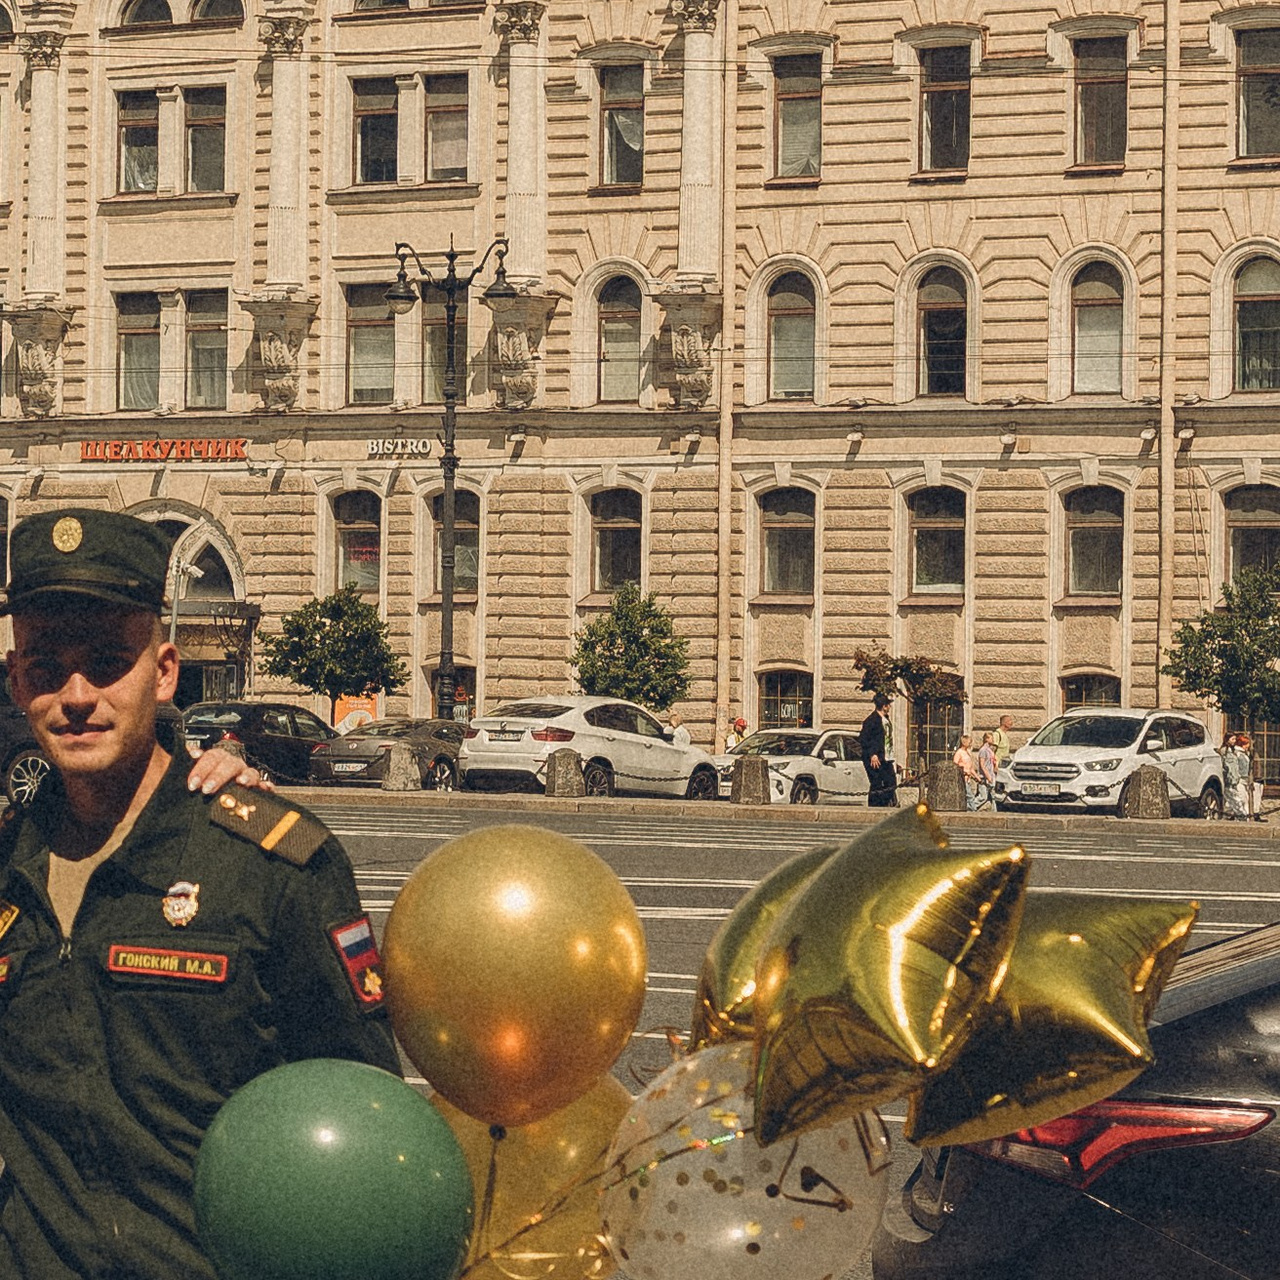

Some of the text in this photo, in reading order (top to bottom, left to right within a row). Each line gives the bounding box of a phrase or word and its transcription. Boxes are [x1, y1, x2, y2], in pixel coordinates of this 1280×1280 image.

[80, 438, 248, 461] ЩЕЛКУНЧИК
[368, 439, 431, 454] BISTRO
[118, 952, 216, 975] ГОНСКИЙ М.А.
